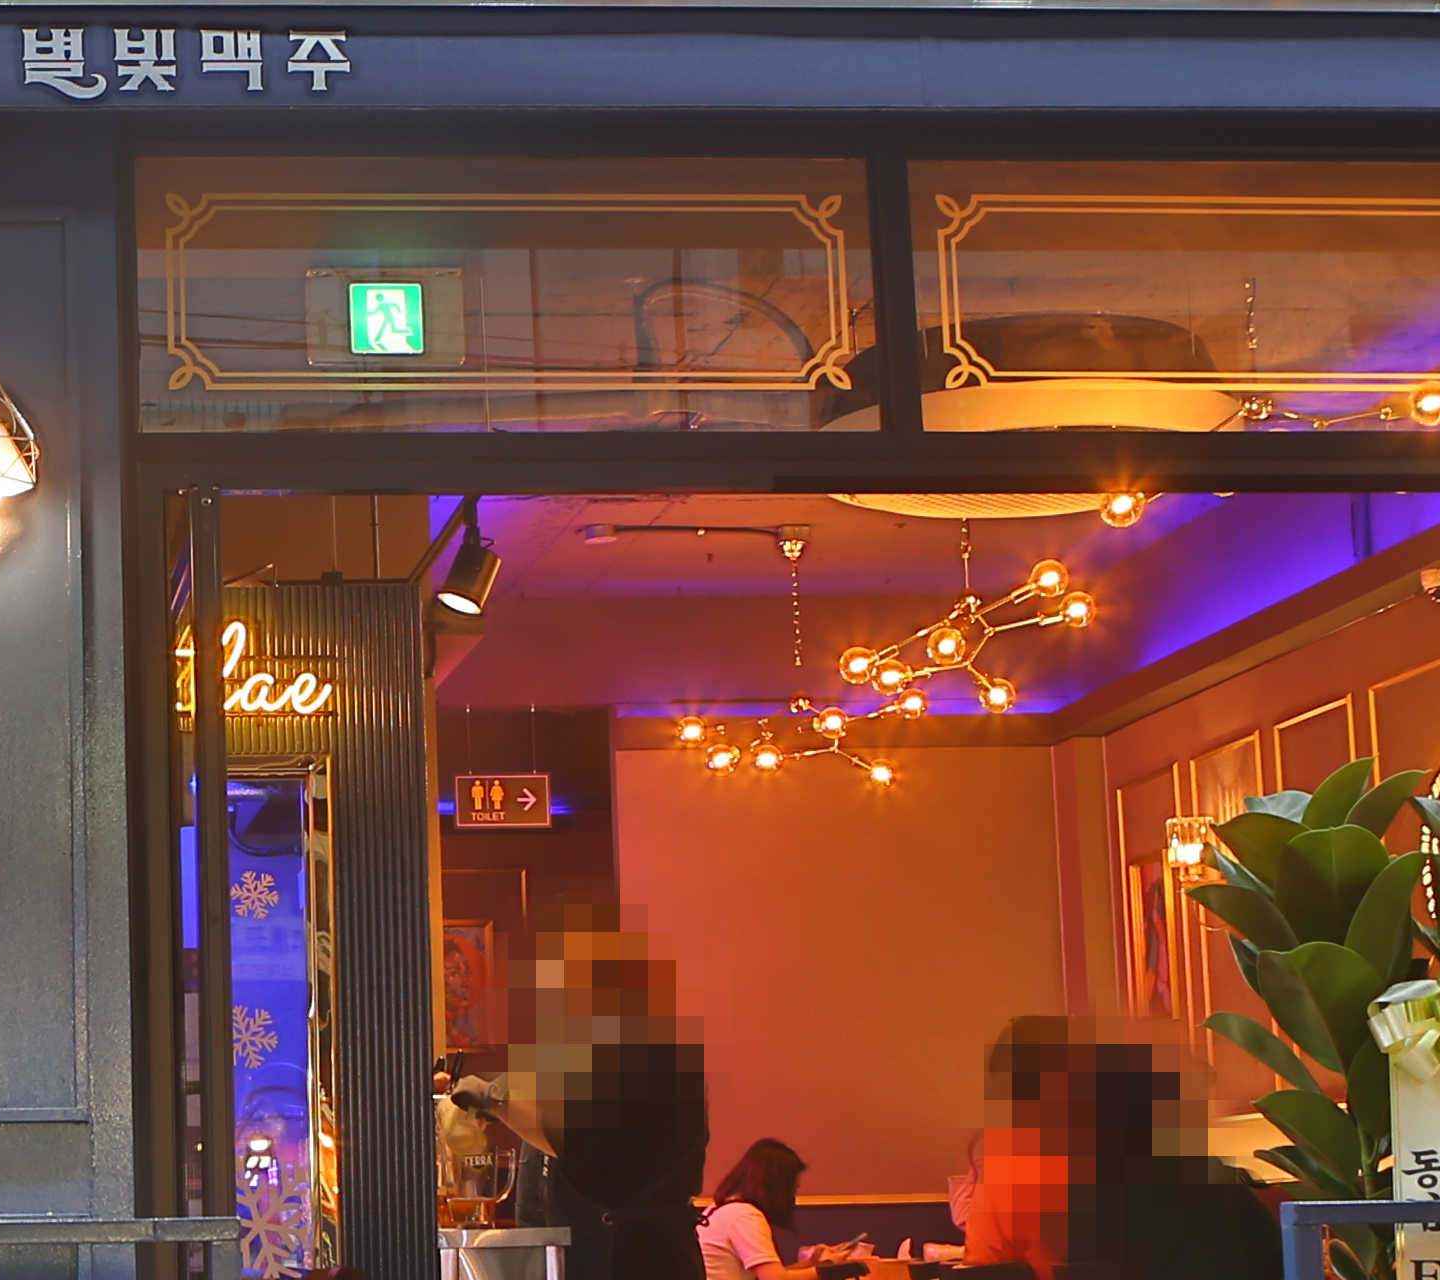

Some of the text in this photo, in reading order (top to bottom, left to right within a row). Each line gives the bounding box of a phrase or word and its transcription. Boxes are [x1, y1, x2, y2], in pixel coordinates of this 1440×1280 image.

[21, 28, 352, 101] 별빛맥주
[471, 812, 505, 821] TOILET
[464, 1154, 494, 1168] TERRA
